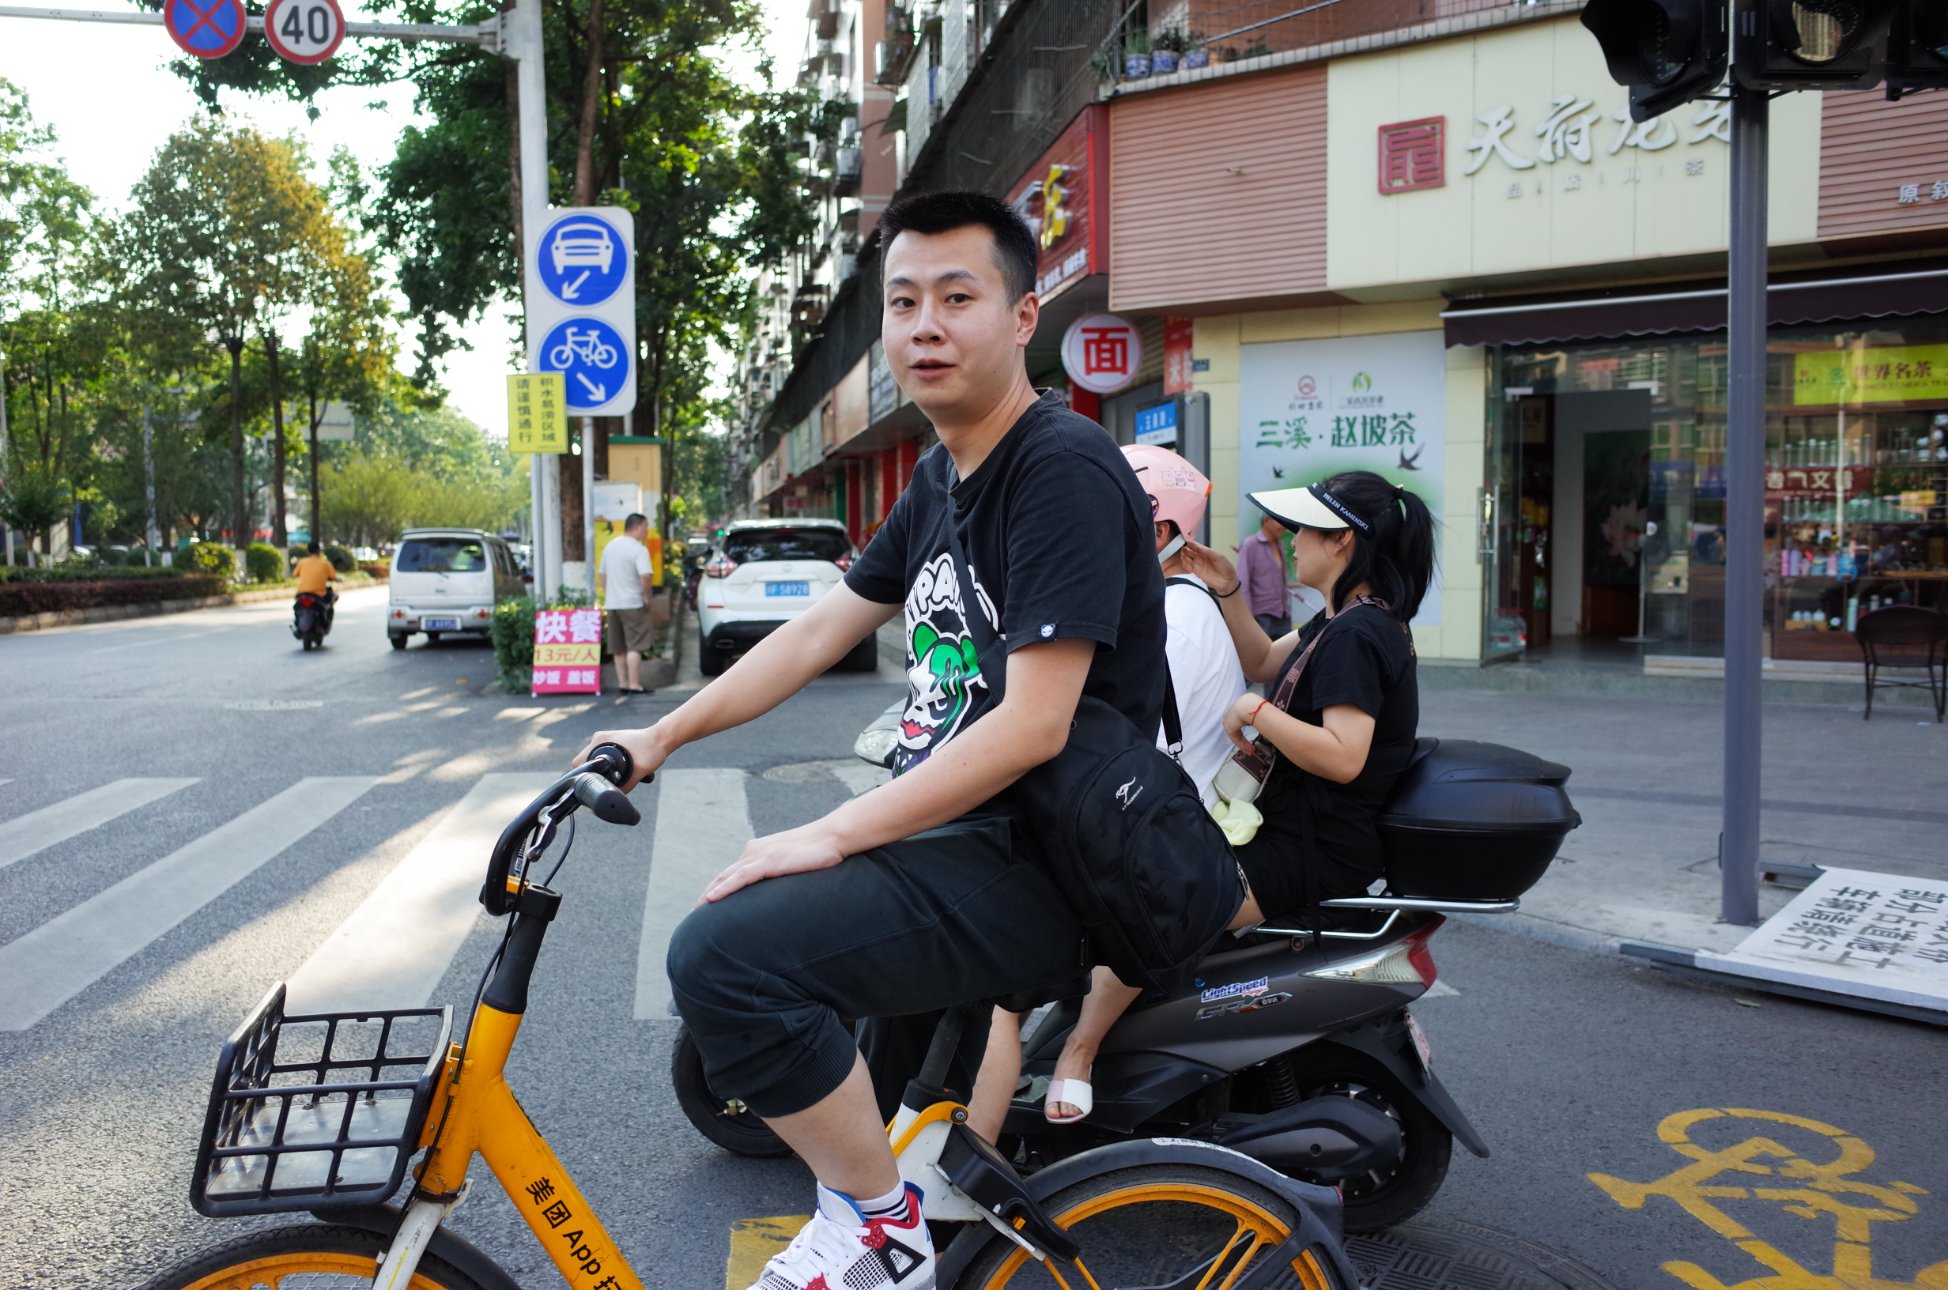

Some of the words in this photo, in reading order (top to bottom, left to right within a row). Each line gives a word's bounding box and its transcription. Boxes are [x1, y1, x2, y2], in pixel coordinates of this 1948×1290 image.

[281, 5, 330, 46] 40
[1081, 327, 1130, 376] 面
[536, 610, 602, 644] 快餐
[534, 647, 596, 662] 13元/人
[525, 1176, 572, 1229] 美团
[562, 1229, 601, 1275] App
